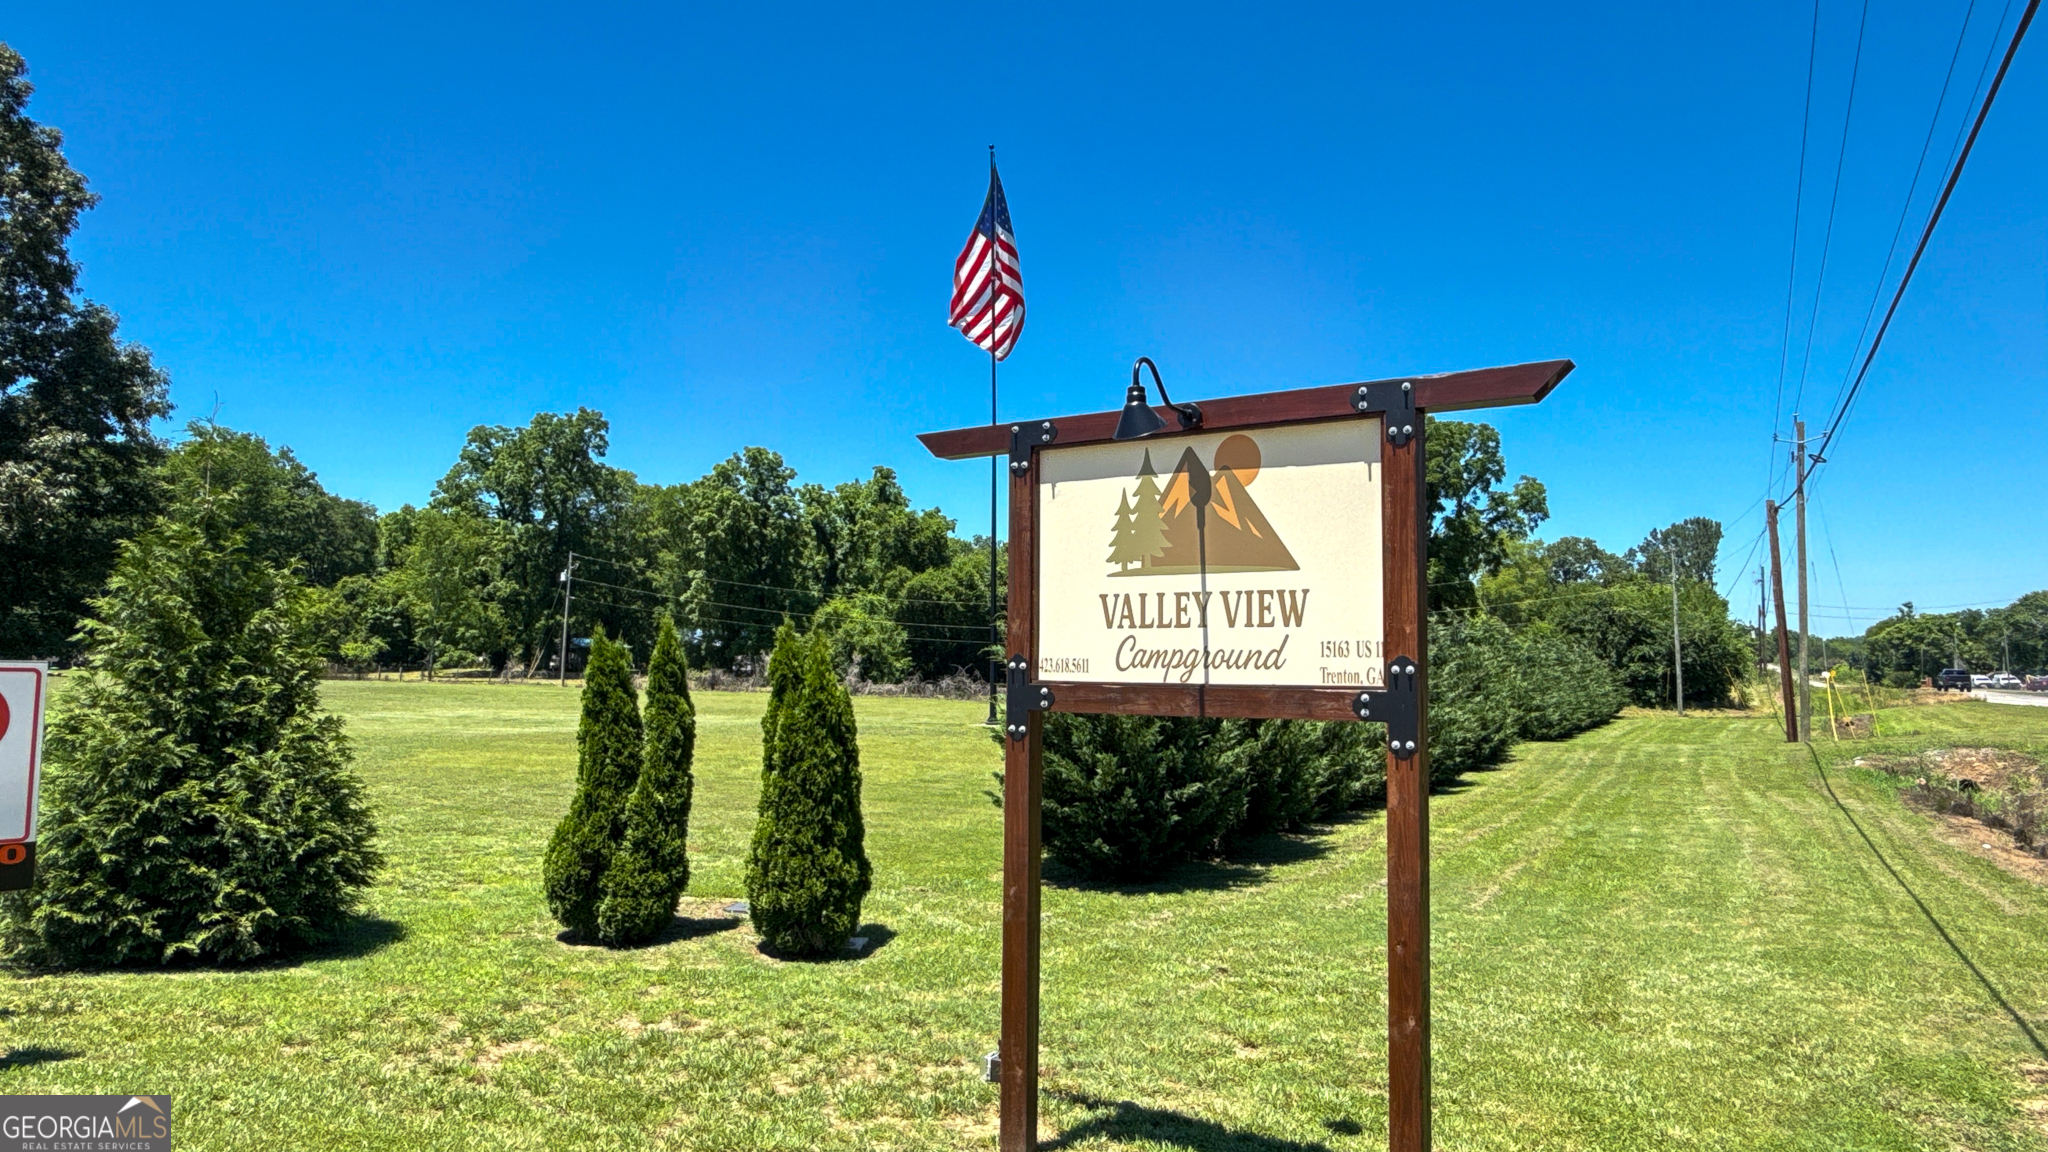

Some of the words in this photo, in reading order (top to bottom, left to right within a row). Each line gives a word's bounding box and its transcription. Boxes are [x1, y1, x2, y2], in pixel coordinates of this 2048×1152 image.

[1099, 591, 1213, 629] VALLEY
[1219, 588, 1310, 628] VIEW
[1115, 634, 1290, 683] Campground
[1320, 640, 1350, 658] 15163
[1356, 640, 1372, 658] US
[1039, 657, 1089, 674] 423.618.5611
[1366, 666, 1384, 685] GA
